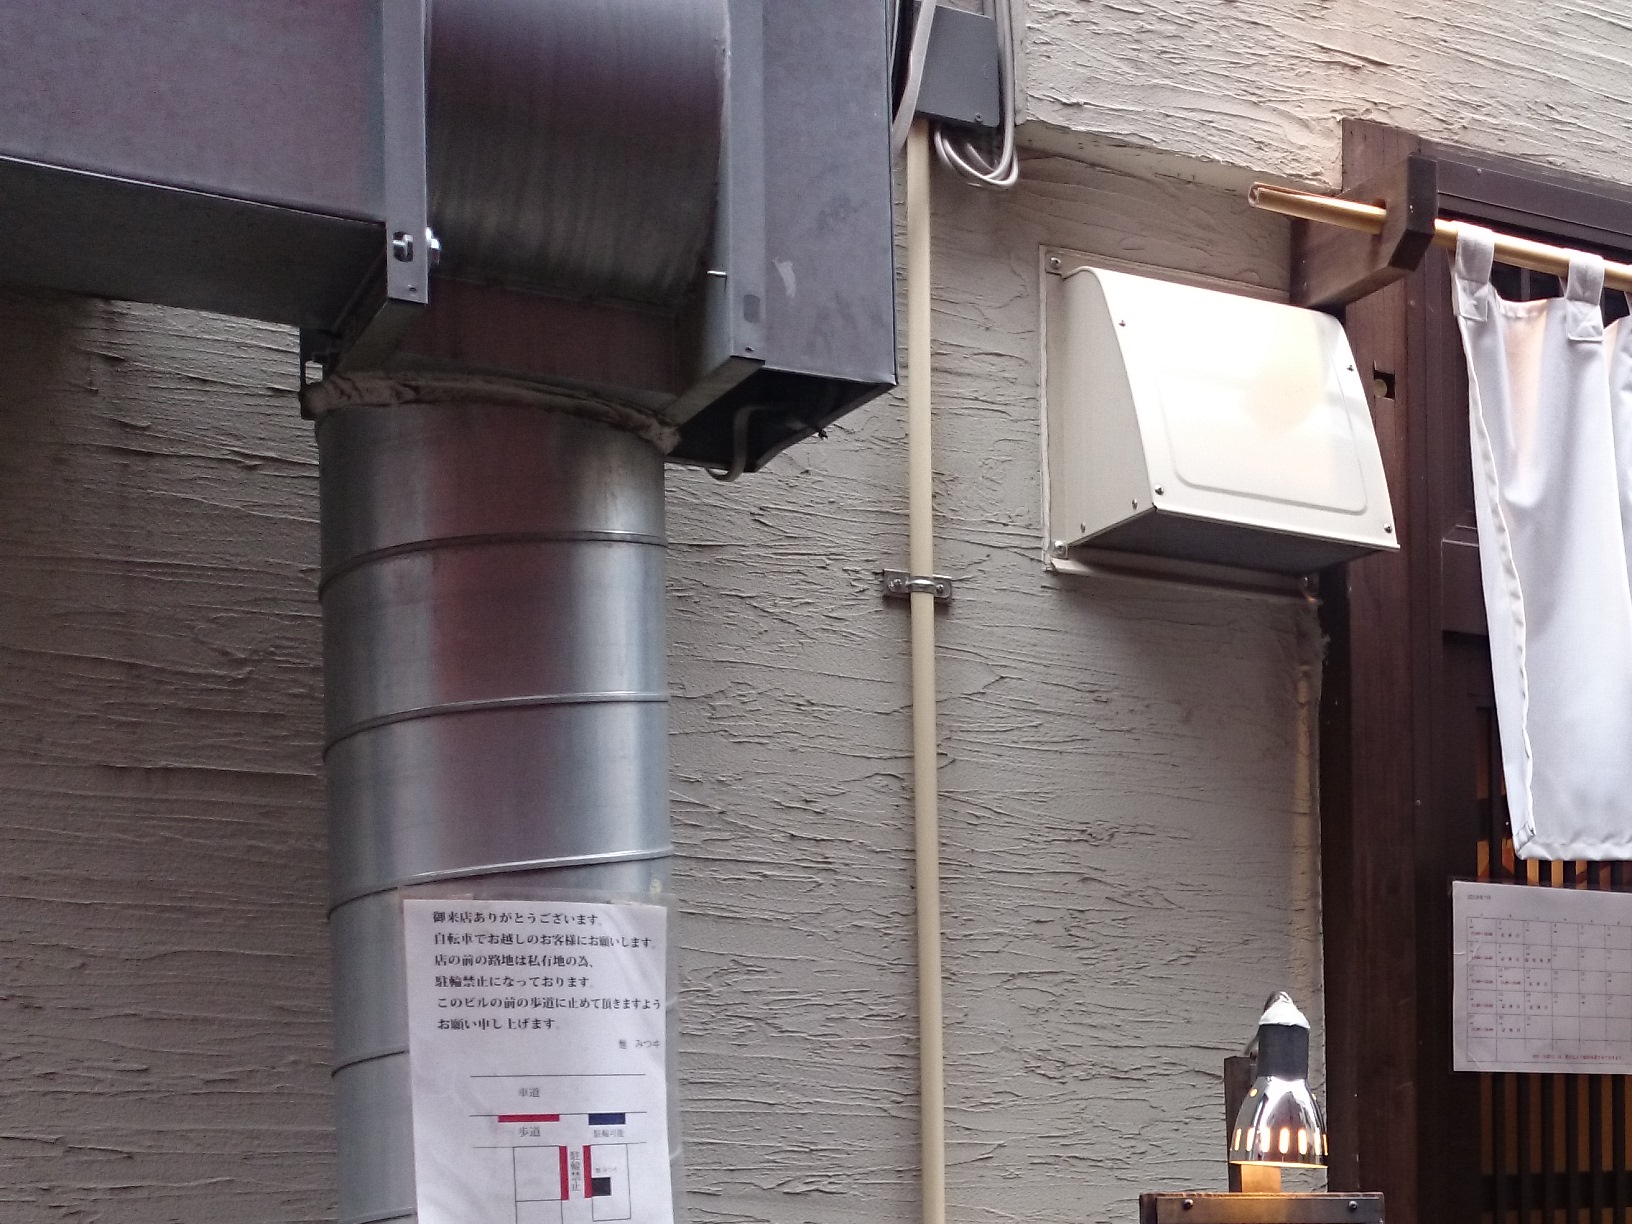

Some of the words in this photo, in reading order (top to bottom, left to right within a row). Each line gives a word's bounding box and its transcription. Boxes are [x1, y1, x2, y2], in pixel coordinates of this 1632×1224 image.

[433, 911, 602, 926] 御来店ありがとうございます。
[434, 932, 656, 949] 自転車でお越しのお客様にお願いします。
[435, 954, 593, 968] 店の前の路地は私有地の為、
[435, 975, 594, 989] 駐輪禁止になっております。
[438, 997, 662, 1011] このビルの前の歩道に止めて頂きますよう
[438, 1018, 561, 1031] お願い申し上げます。
[518, 1087, 541, 1098] 車道
[519, 1126, 541, 1138] 歩道
